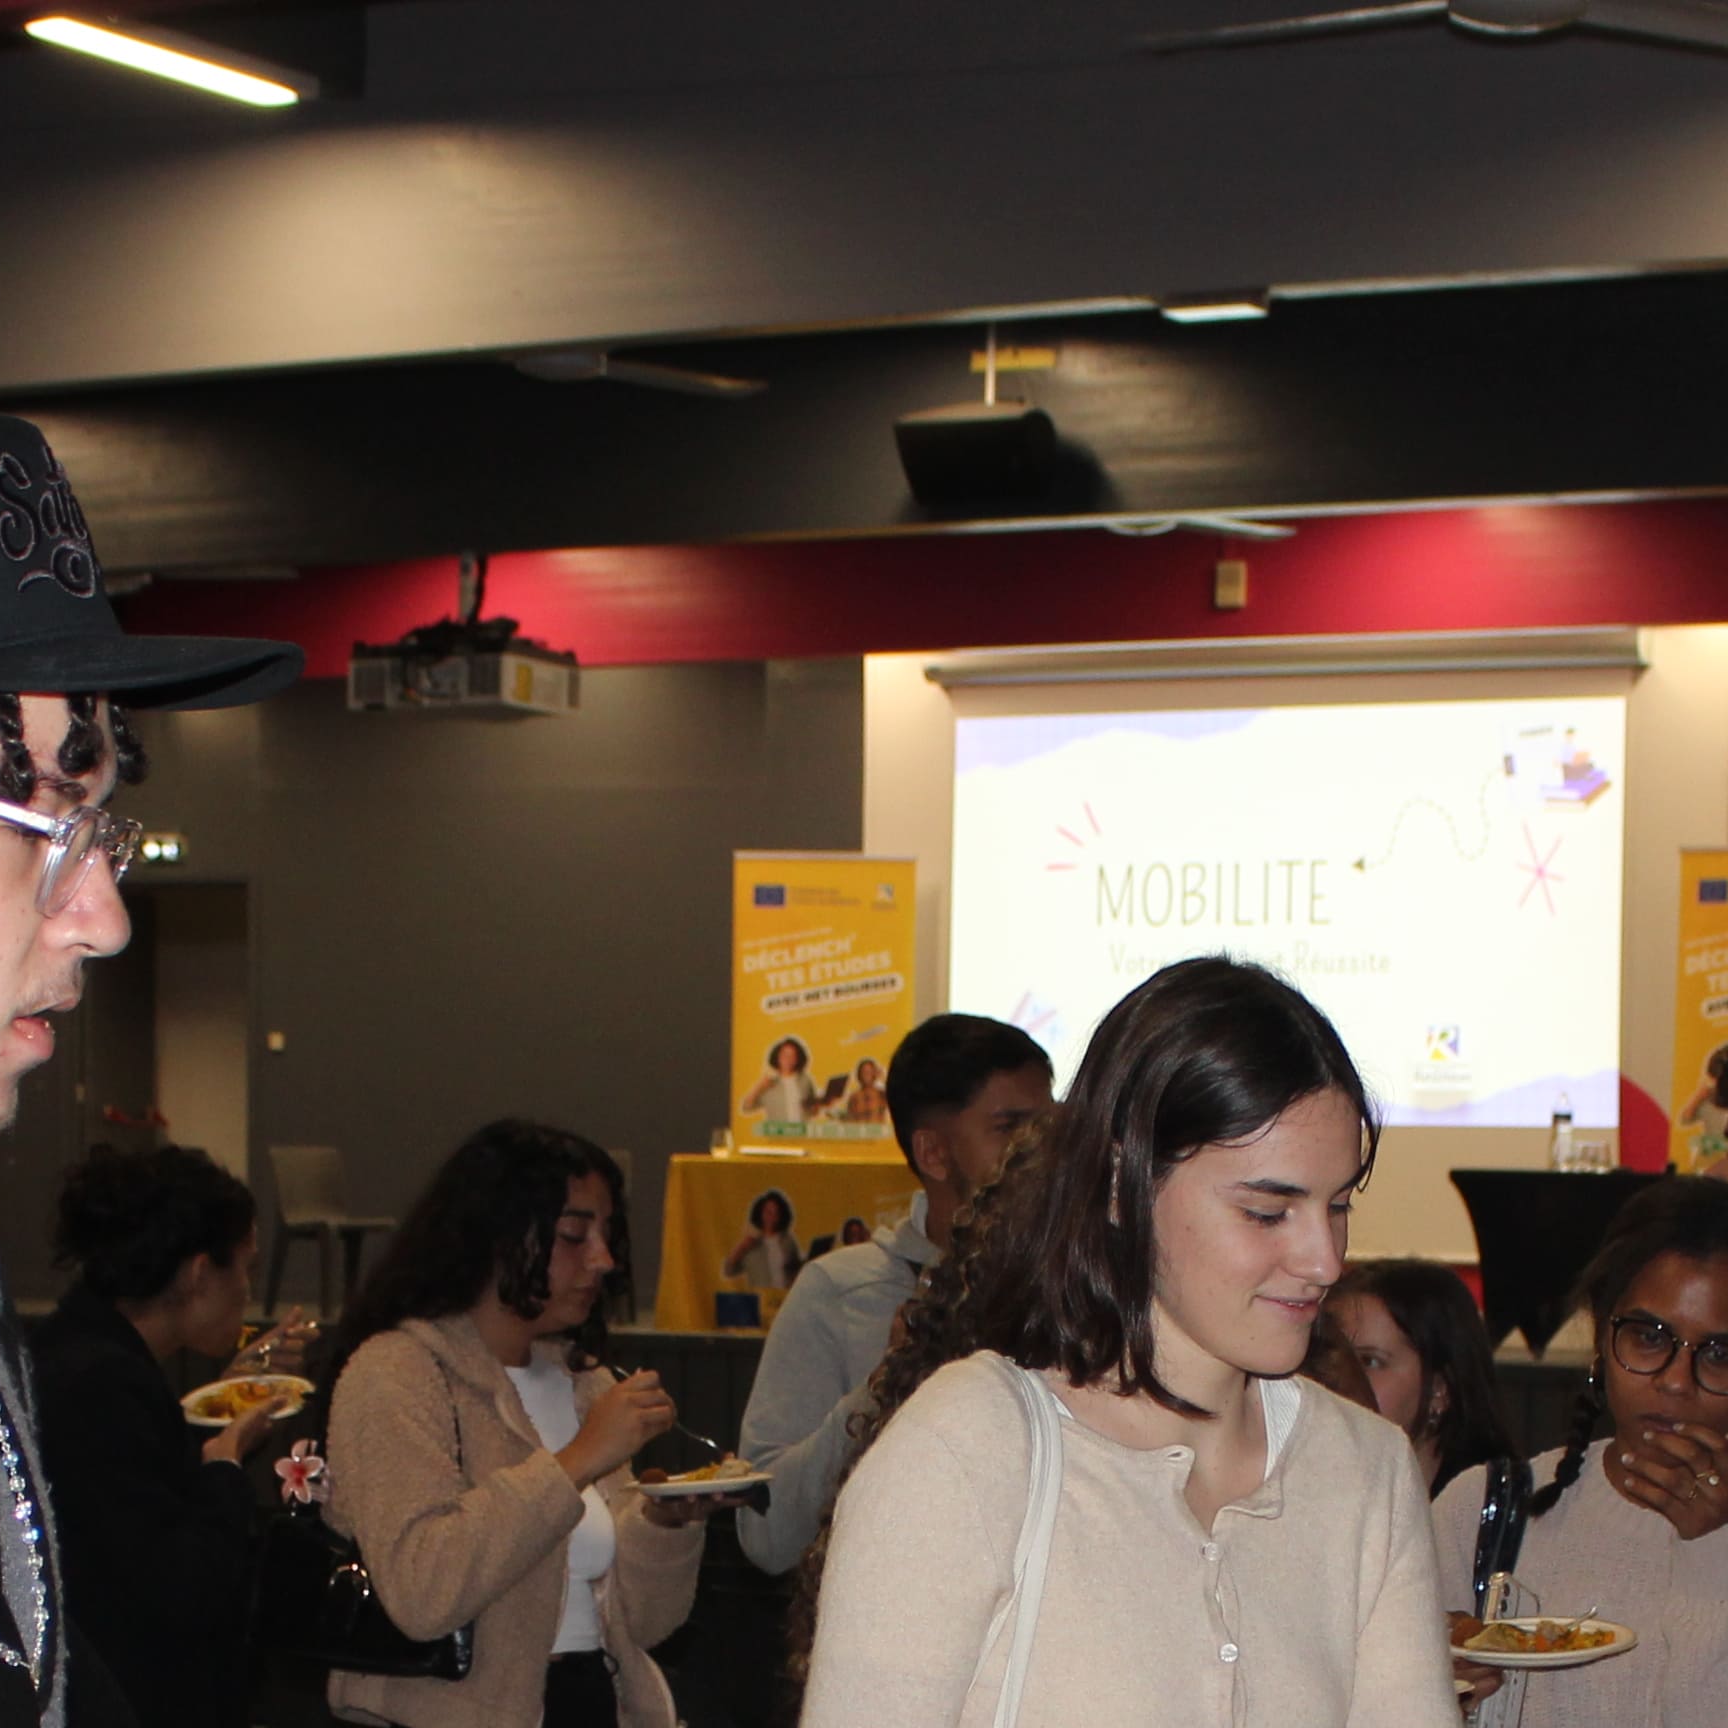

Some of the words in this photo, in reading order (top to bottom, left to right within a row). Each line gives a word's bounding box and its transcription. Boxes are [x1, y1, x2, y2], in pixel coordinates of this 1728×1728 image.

[1095, 859, 1331, 928] MOBILITE
[766, 965, 805, 990] TES
[808, 950, 892, 984] ÉTUDES
